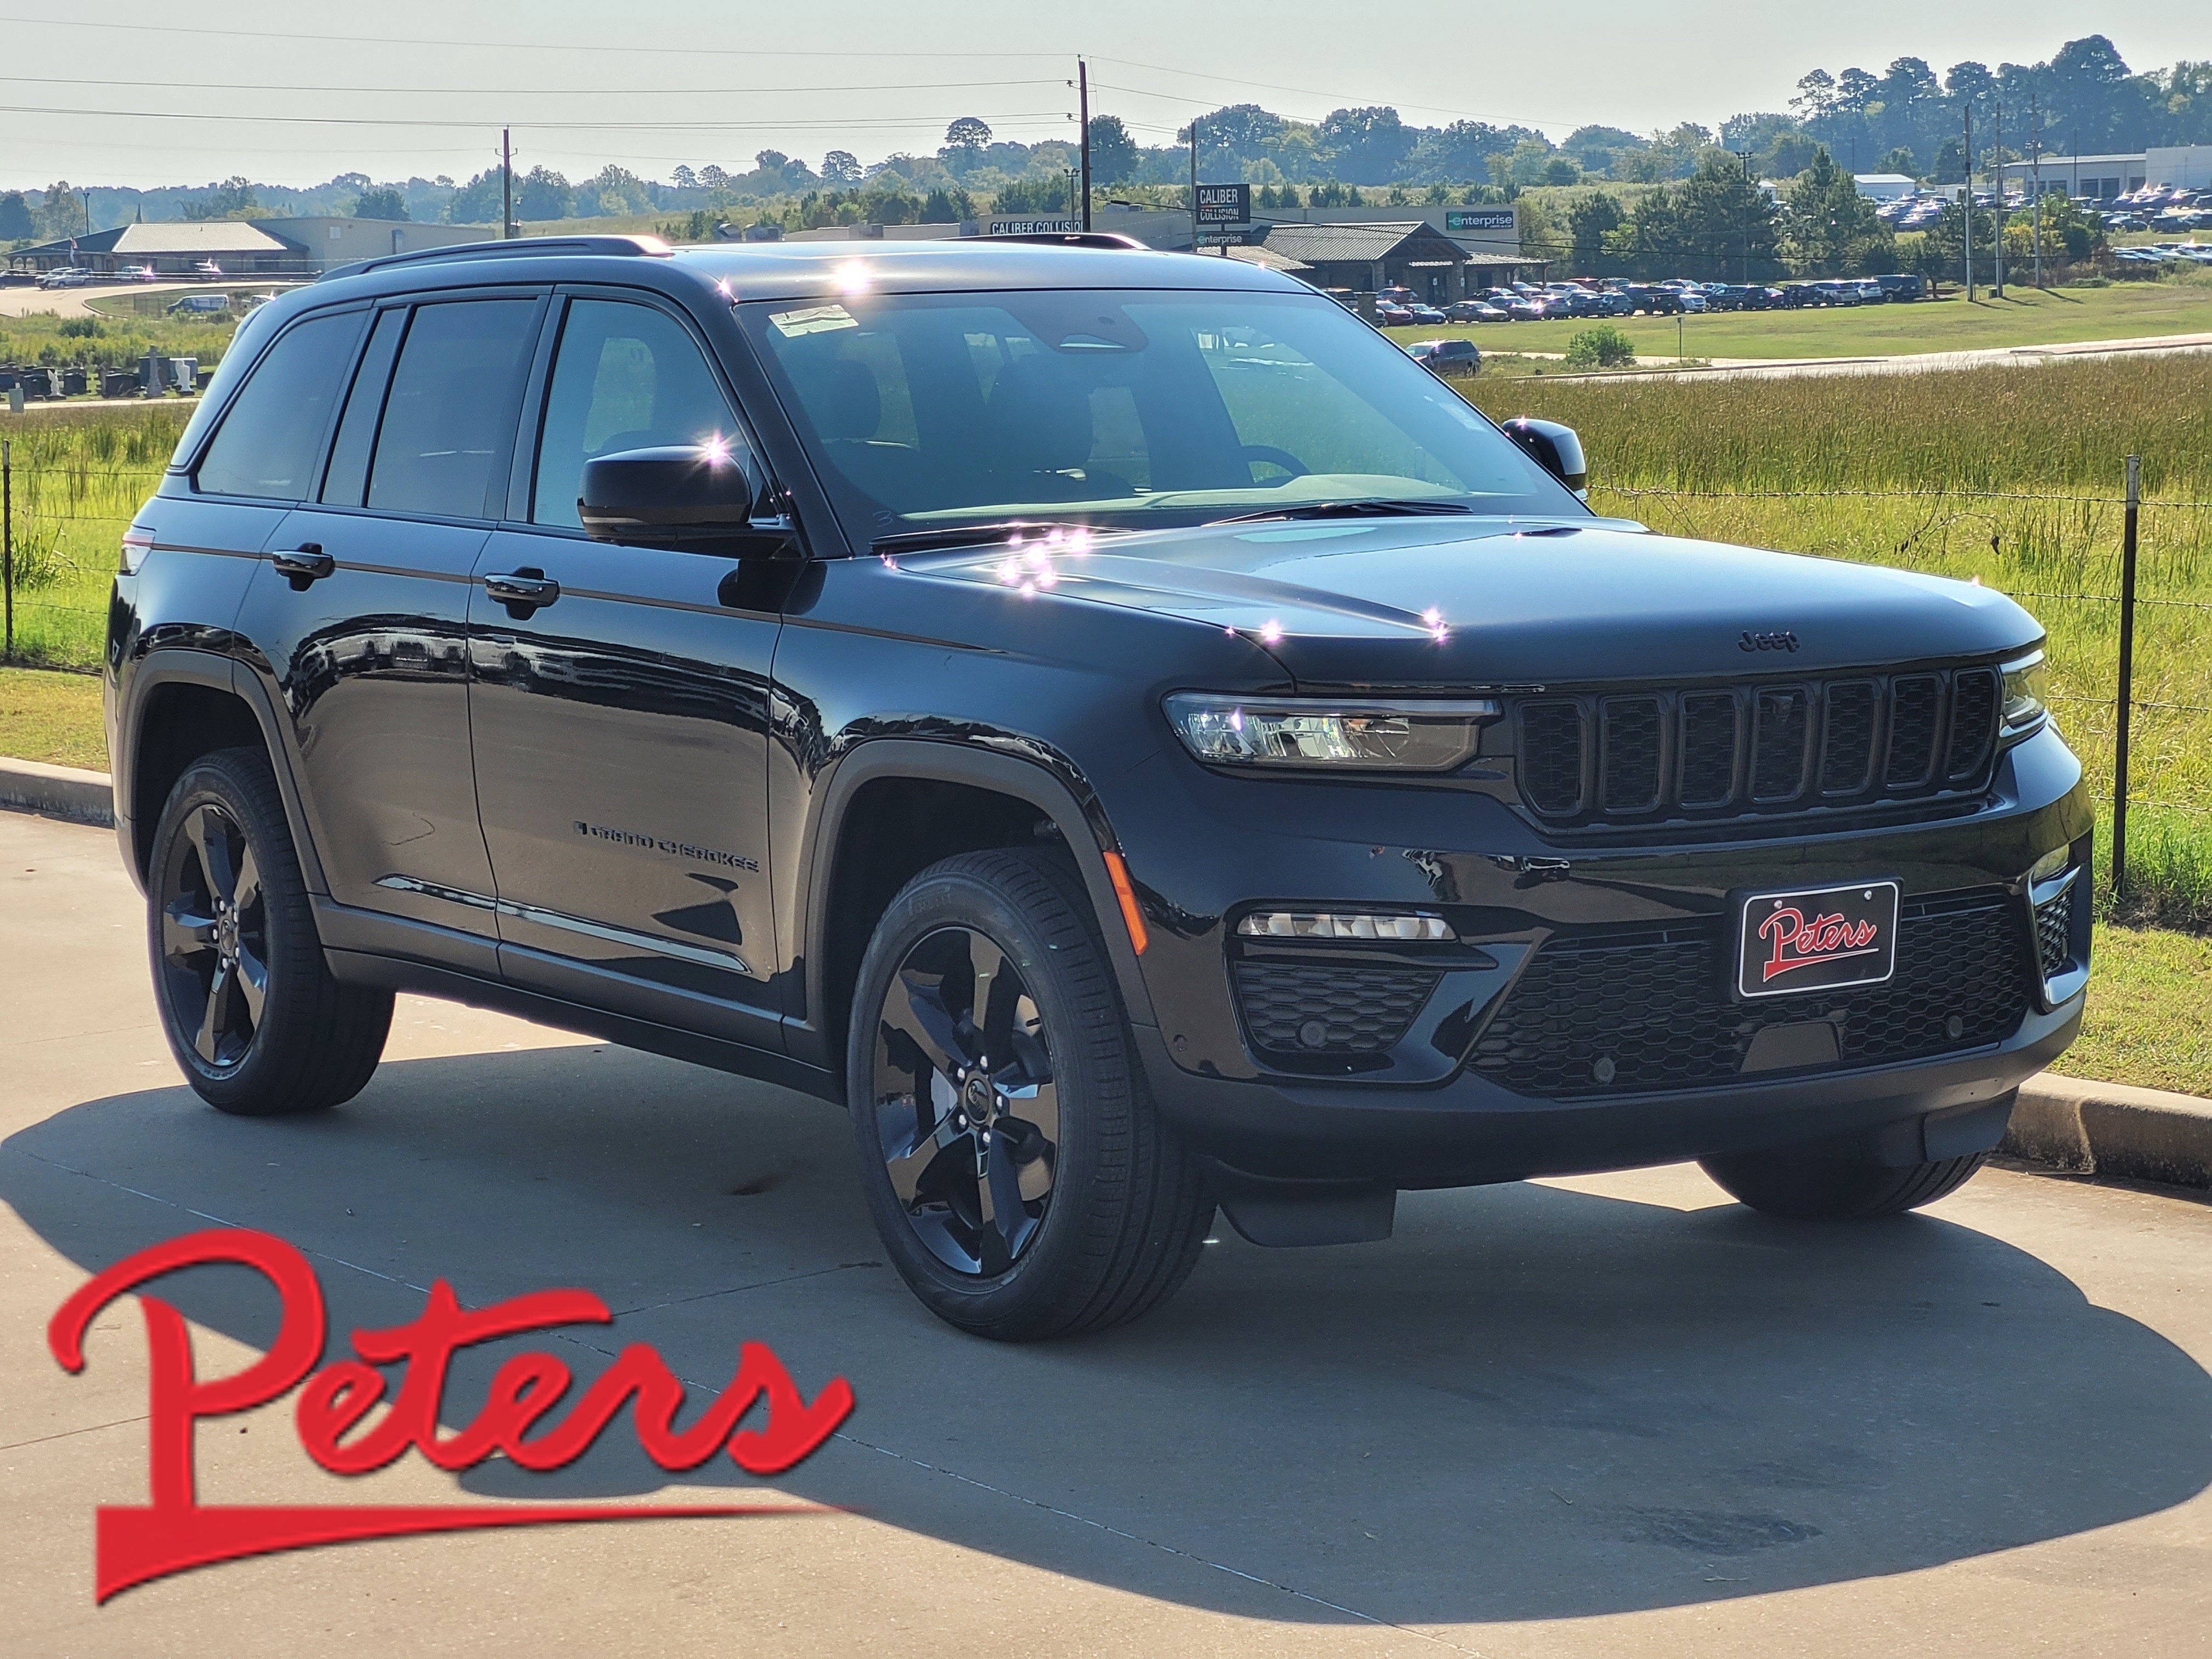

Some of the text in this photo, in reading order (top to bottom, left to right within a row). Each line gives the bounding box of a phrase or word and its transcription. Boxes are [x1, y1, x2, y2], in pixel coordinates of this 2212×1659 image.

[1200, 188, 1238, 204] CALIBER
[1200, 208, 1239, 221] COLLISION
[1448, 215, 1513, 228] enterprise
[992, 221, 1083, 235] CALIBER COLLISIO
[1197, 234, 1242, 245] enterprise
[1738, 630, 1800, 653] Jeep
[590, 825, 759, 873] GRAND CHEROKEE
[1758, 907, 1878, 983] Peters
